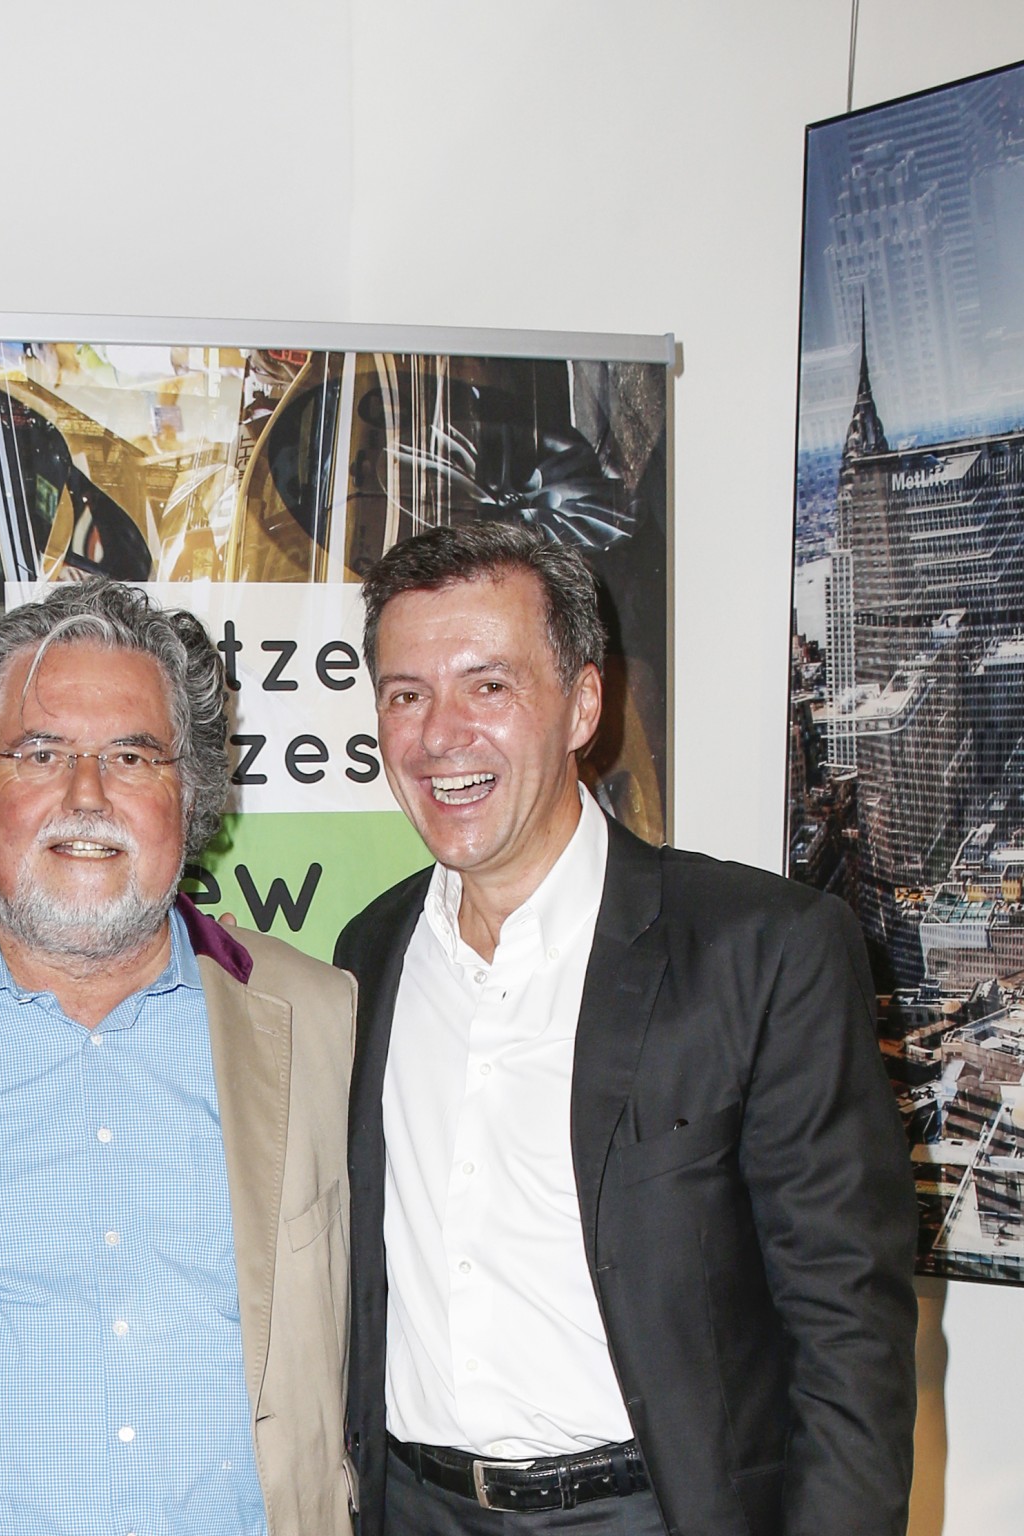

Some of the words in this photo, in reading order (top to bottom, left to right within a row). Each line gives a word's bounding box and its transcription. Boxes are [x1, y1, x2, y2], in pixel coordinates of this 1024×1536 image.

[217, 620, 360, 691] tze
[230, 733, 380, 784] zes
[179, 862, 323, 932] ew
